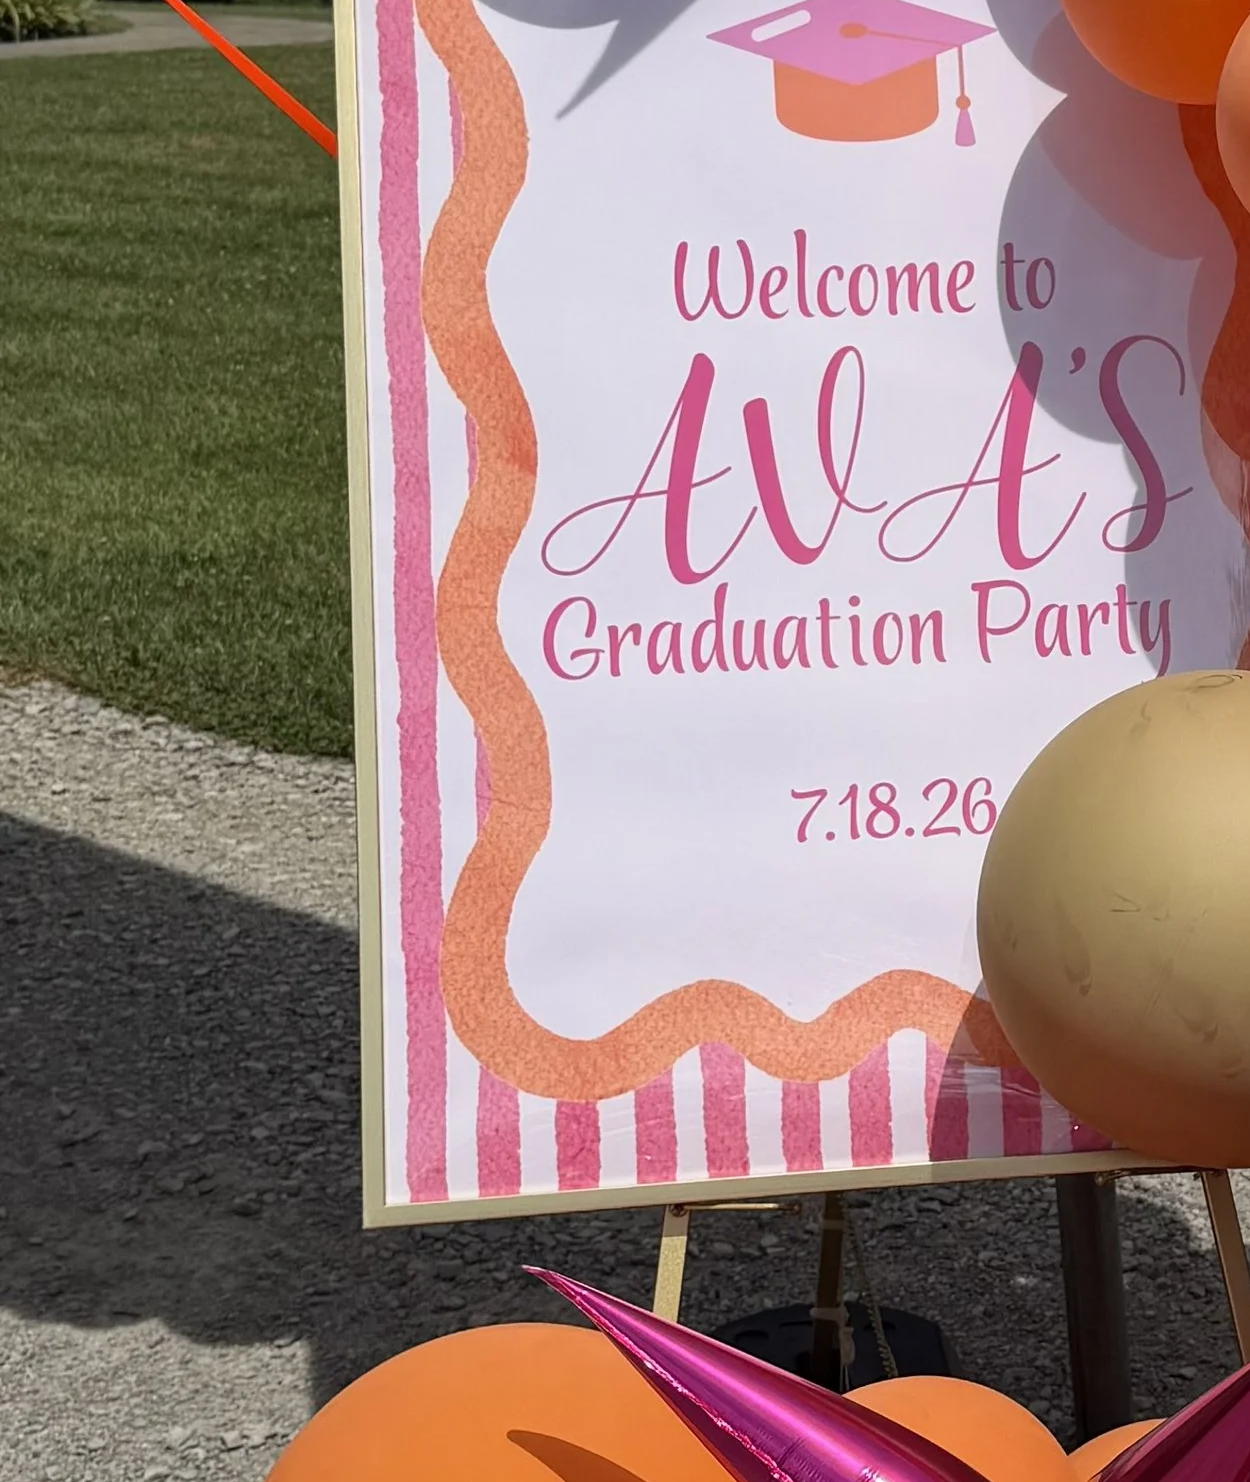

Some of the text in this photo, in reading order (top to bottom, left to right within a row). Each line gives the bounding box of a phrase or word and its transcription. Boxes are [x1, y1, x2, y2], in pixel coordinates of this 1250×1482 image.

[672, 228, 1056, 322] Welcome to
[541, 335, 1194, 586] AVA'S
[542, 579, 1170, 681] Graduation Party
[790, 776, 998, 844] 7.18.26
